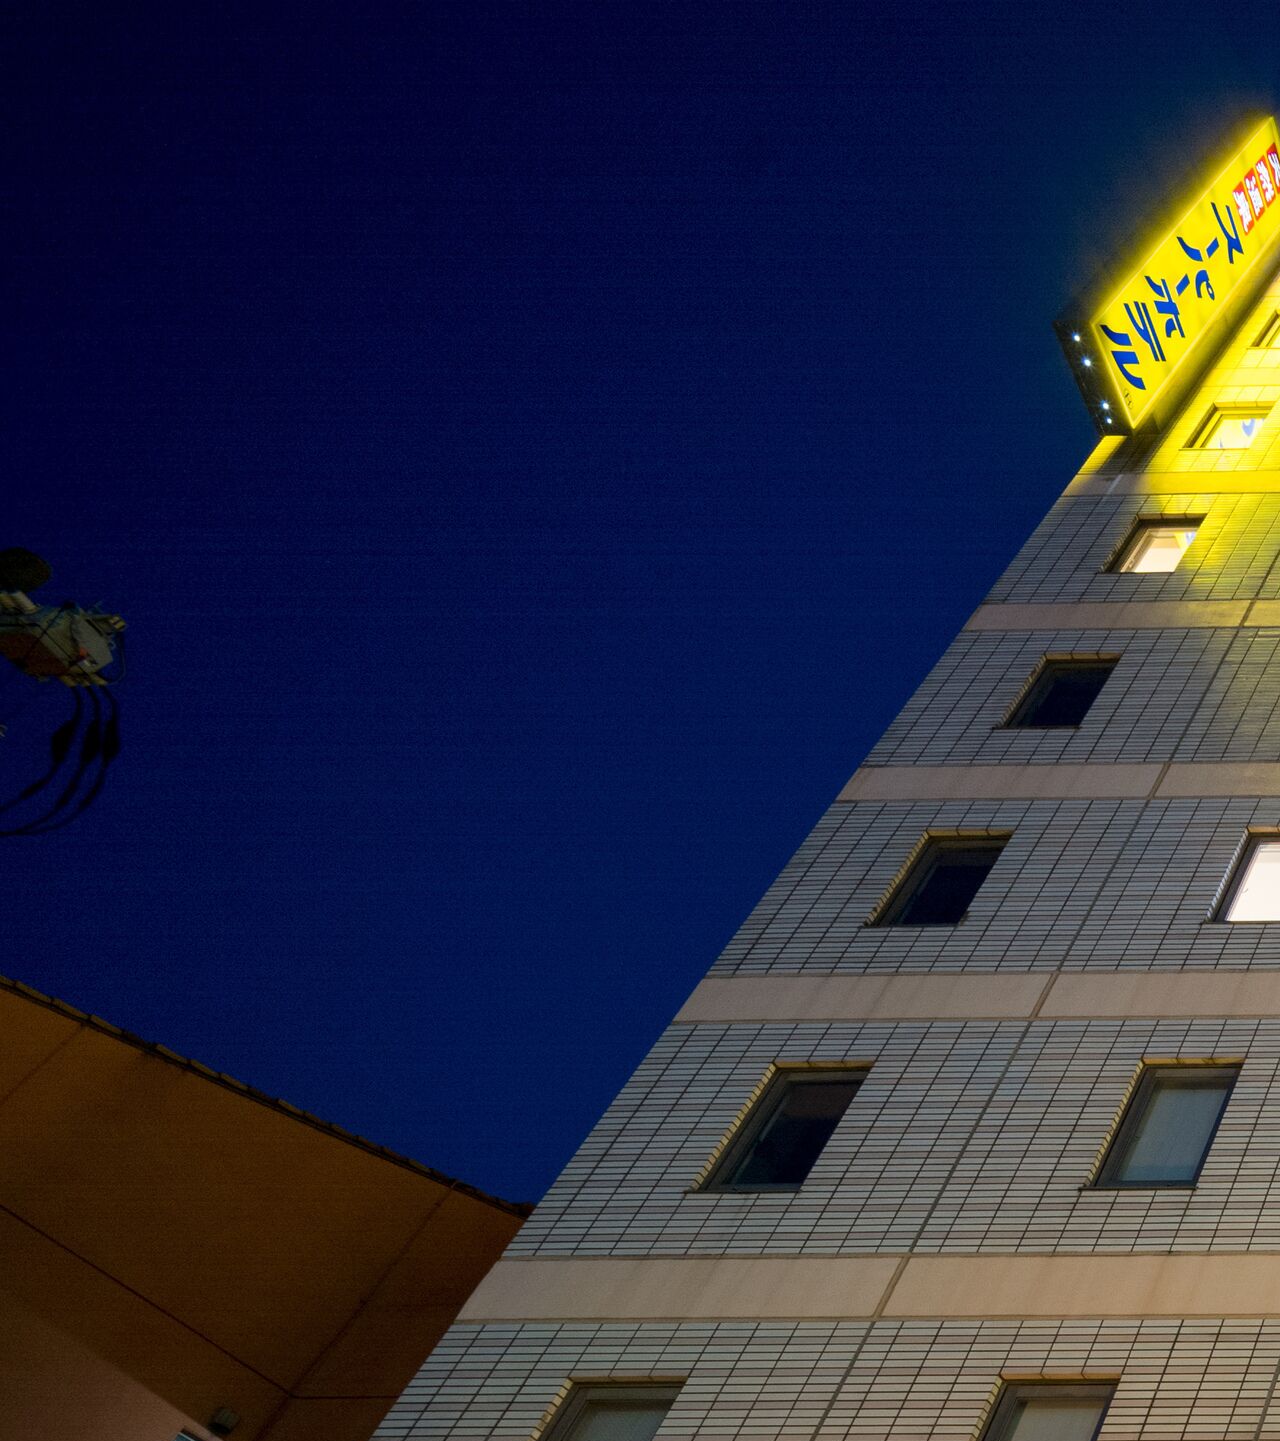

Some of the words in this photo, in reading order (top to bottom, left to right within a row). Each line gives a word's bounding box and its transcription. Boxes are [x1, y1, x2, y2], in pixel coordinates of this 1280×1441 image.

[1100, 202, 1243, 390] スーパーホテル
